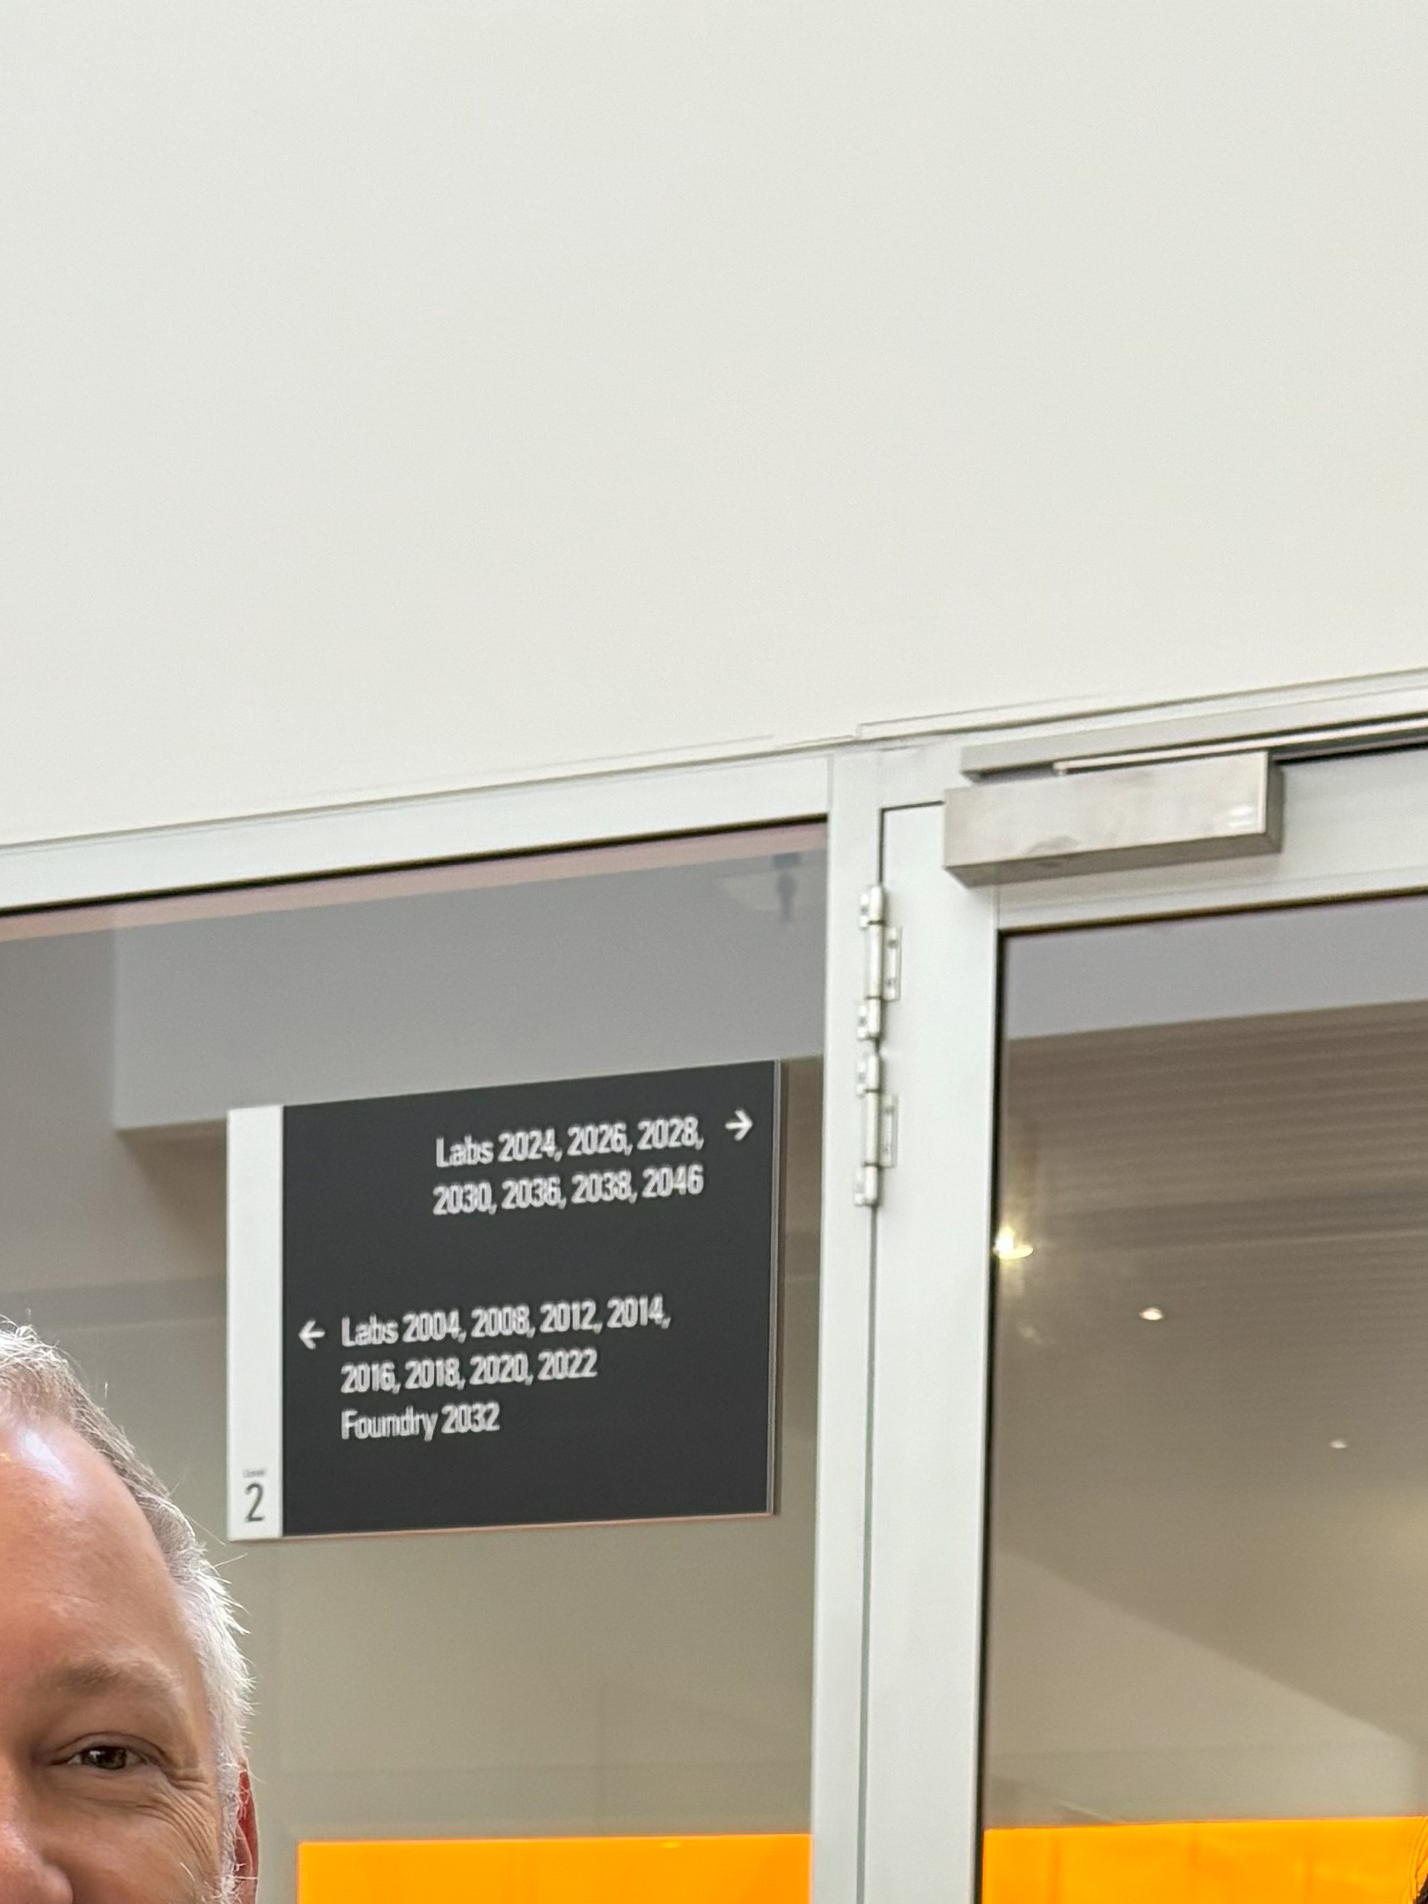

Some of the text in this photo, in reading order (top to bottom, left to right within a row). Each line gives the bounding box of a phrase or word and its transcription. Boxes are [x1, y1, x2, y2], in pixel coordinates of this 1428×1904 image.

[436, 1116, 704, 1168] Labs 2024, 2026, 2028,
[432, 1162, 704, 1215] 2030, 2036, 2038, 2046
[341, 1293, 671, 1347] Labs 2004, 2008, 2012, 2014,
[340, 1347, 598, 1395] 2016, 2018, 2020, 2022
[341, 1400, 501, 1442] Foundry 2032
[243, 1481, 266, 1523] 2
